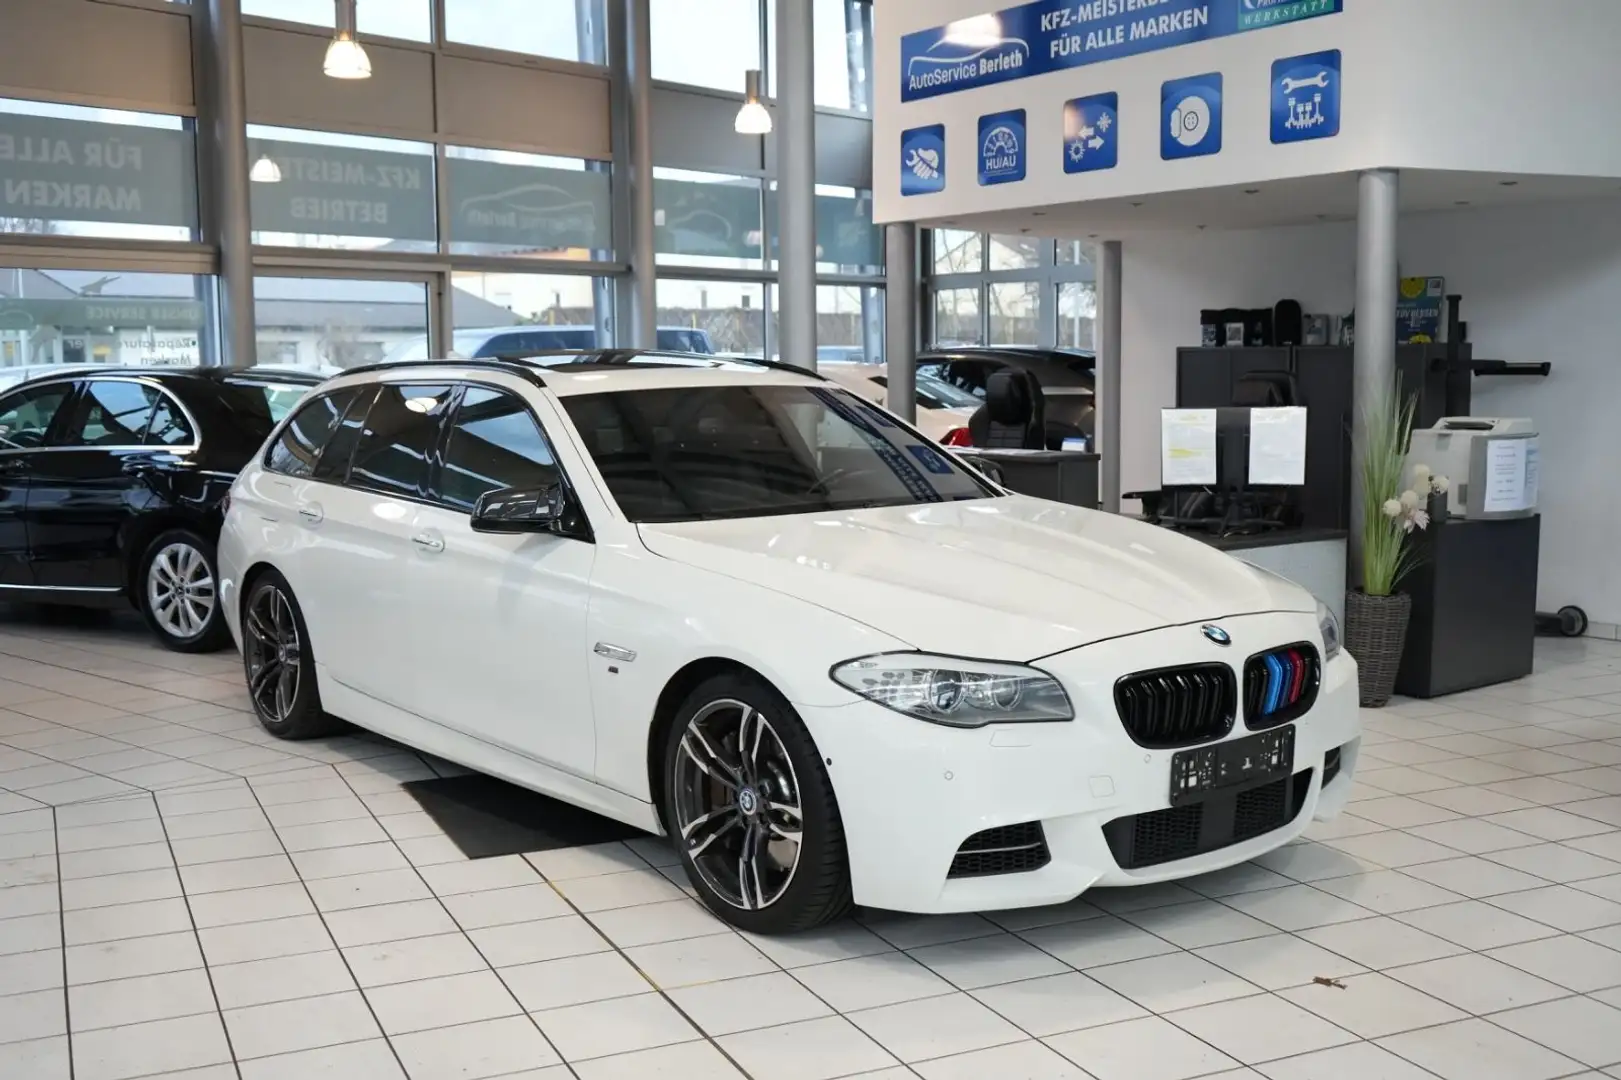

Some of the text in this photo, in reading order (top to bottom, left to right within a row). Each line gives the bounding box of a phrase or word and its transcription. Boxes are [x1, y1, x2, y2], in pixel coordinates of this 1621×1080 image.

[1041, 0, 1170, 32] KFZ-MEISTE
[1244, 0, 1327, 25] WERKSTATT
[1050, 6, 1209, 58] FÜR ALLE MARKEN
[909, 49, 1023, 91] AutoService Berleth
